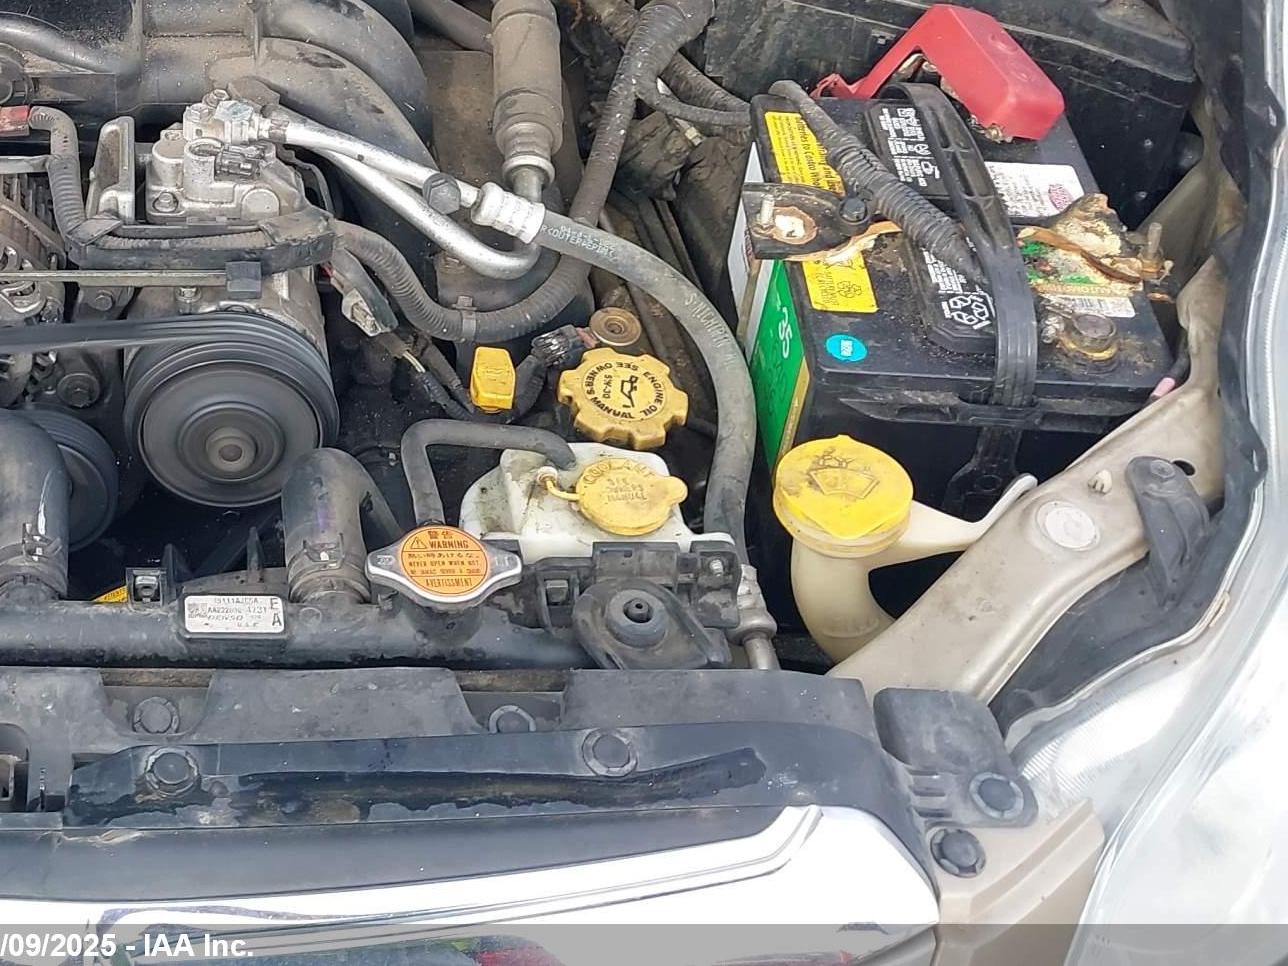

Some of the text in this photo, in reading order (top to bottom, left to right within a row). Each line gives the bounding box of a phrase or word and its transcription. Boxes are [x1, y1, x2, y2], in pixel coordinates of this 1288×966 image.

[616, 361, 639, 371] SEE
[640, 371, 664, 417] ENGINE OIL
[591, 397, 635, 419] MANUAL
[429, 540, 469, 549] WARNING
